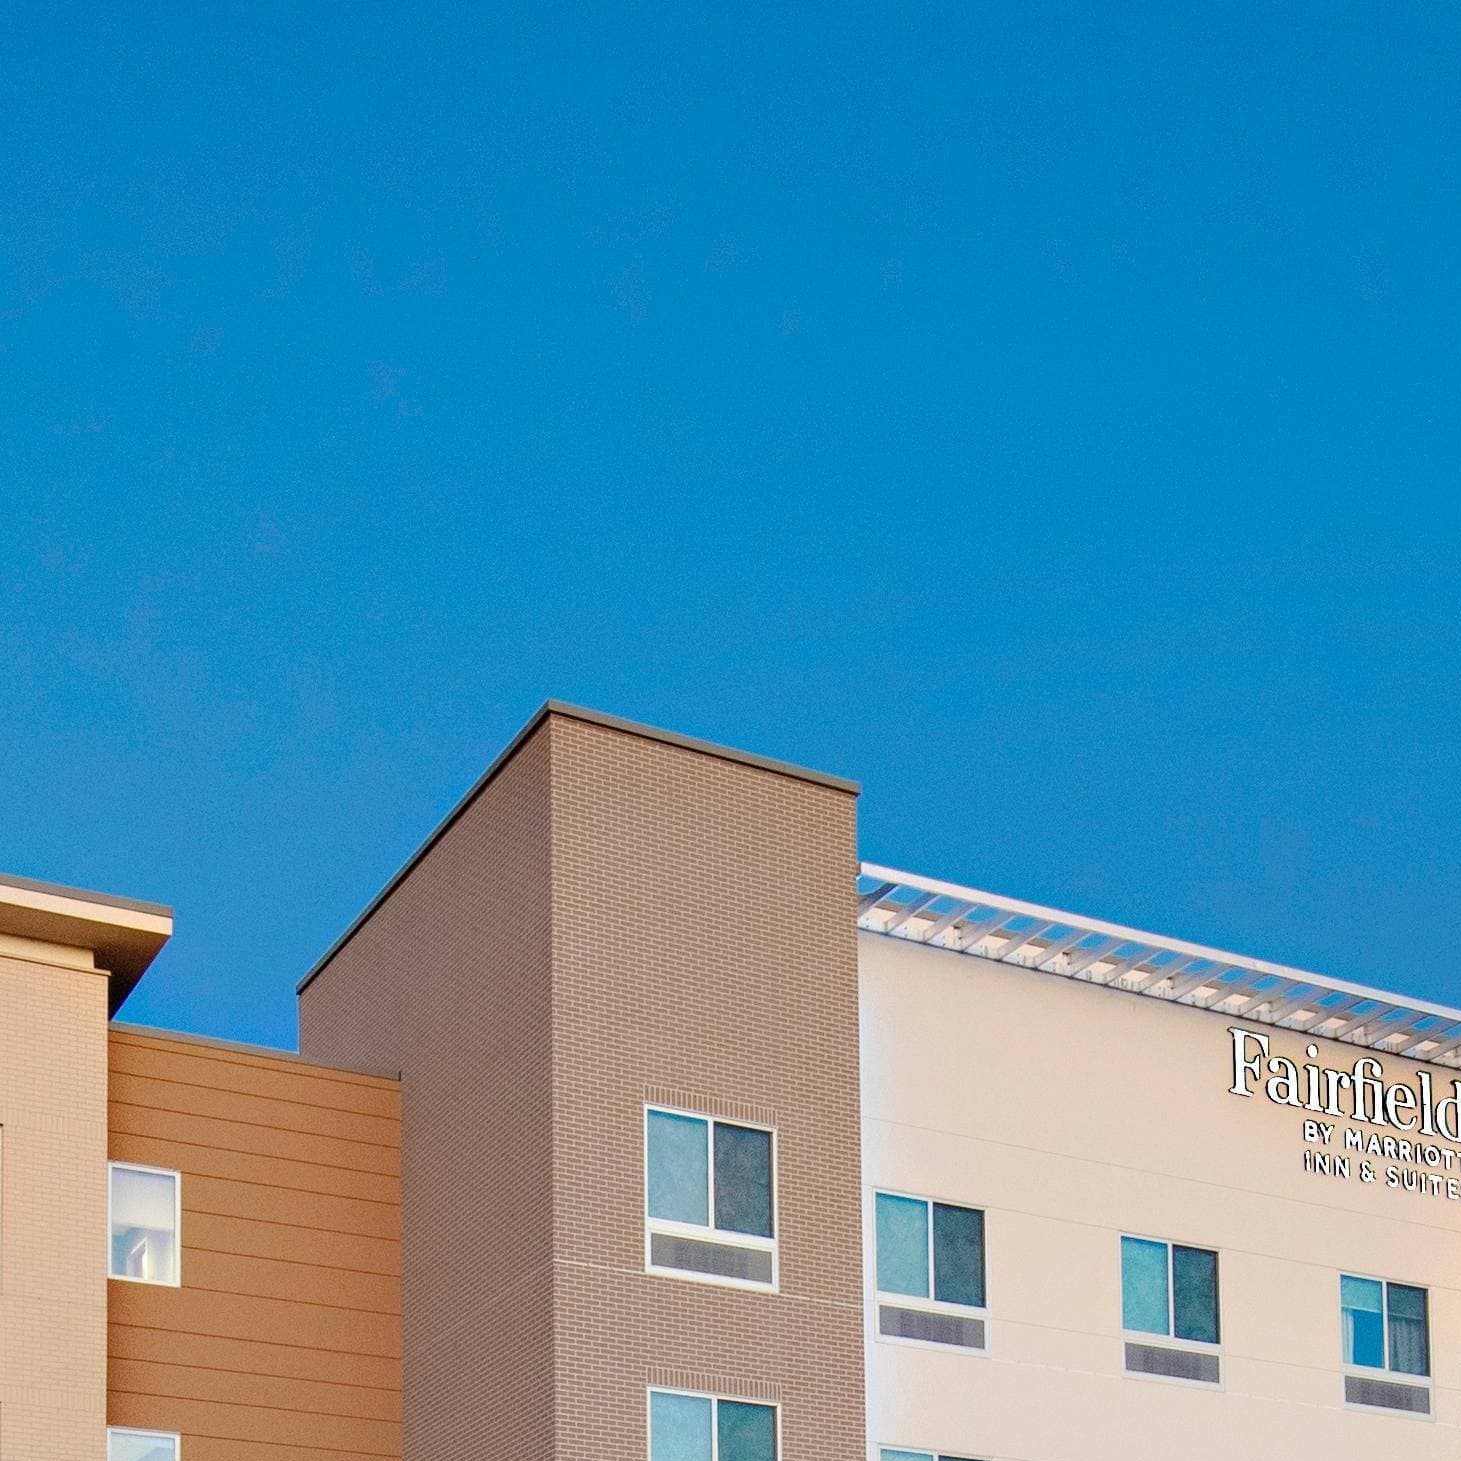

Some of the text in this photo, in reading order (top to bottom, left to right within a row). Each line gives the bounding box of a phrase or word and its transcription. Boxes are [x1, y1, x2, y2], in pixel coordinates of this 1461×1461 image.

[1303, 1120, 1335, 1146] BY
[1304, 1150, 1350, 1178] INN
[1360, 1161, 1376, 1183] &
